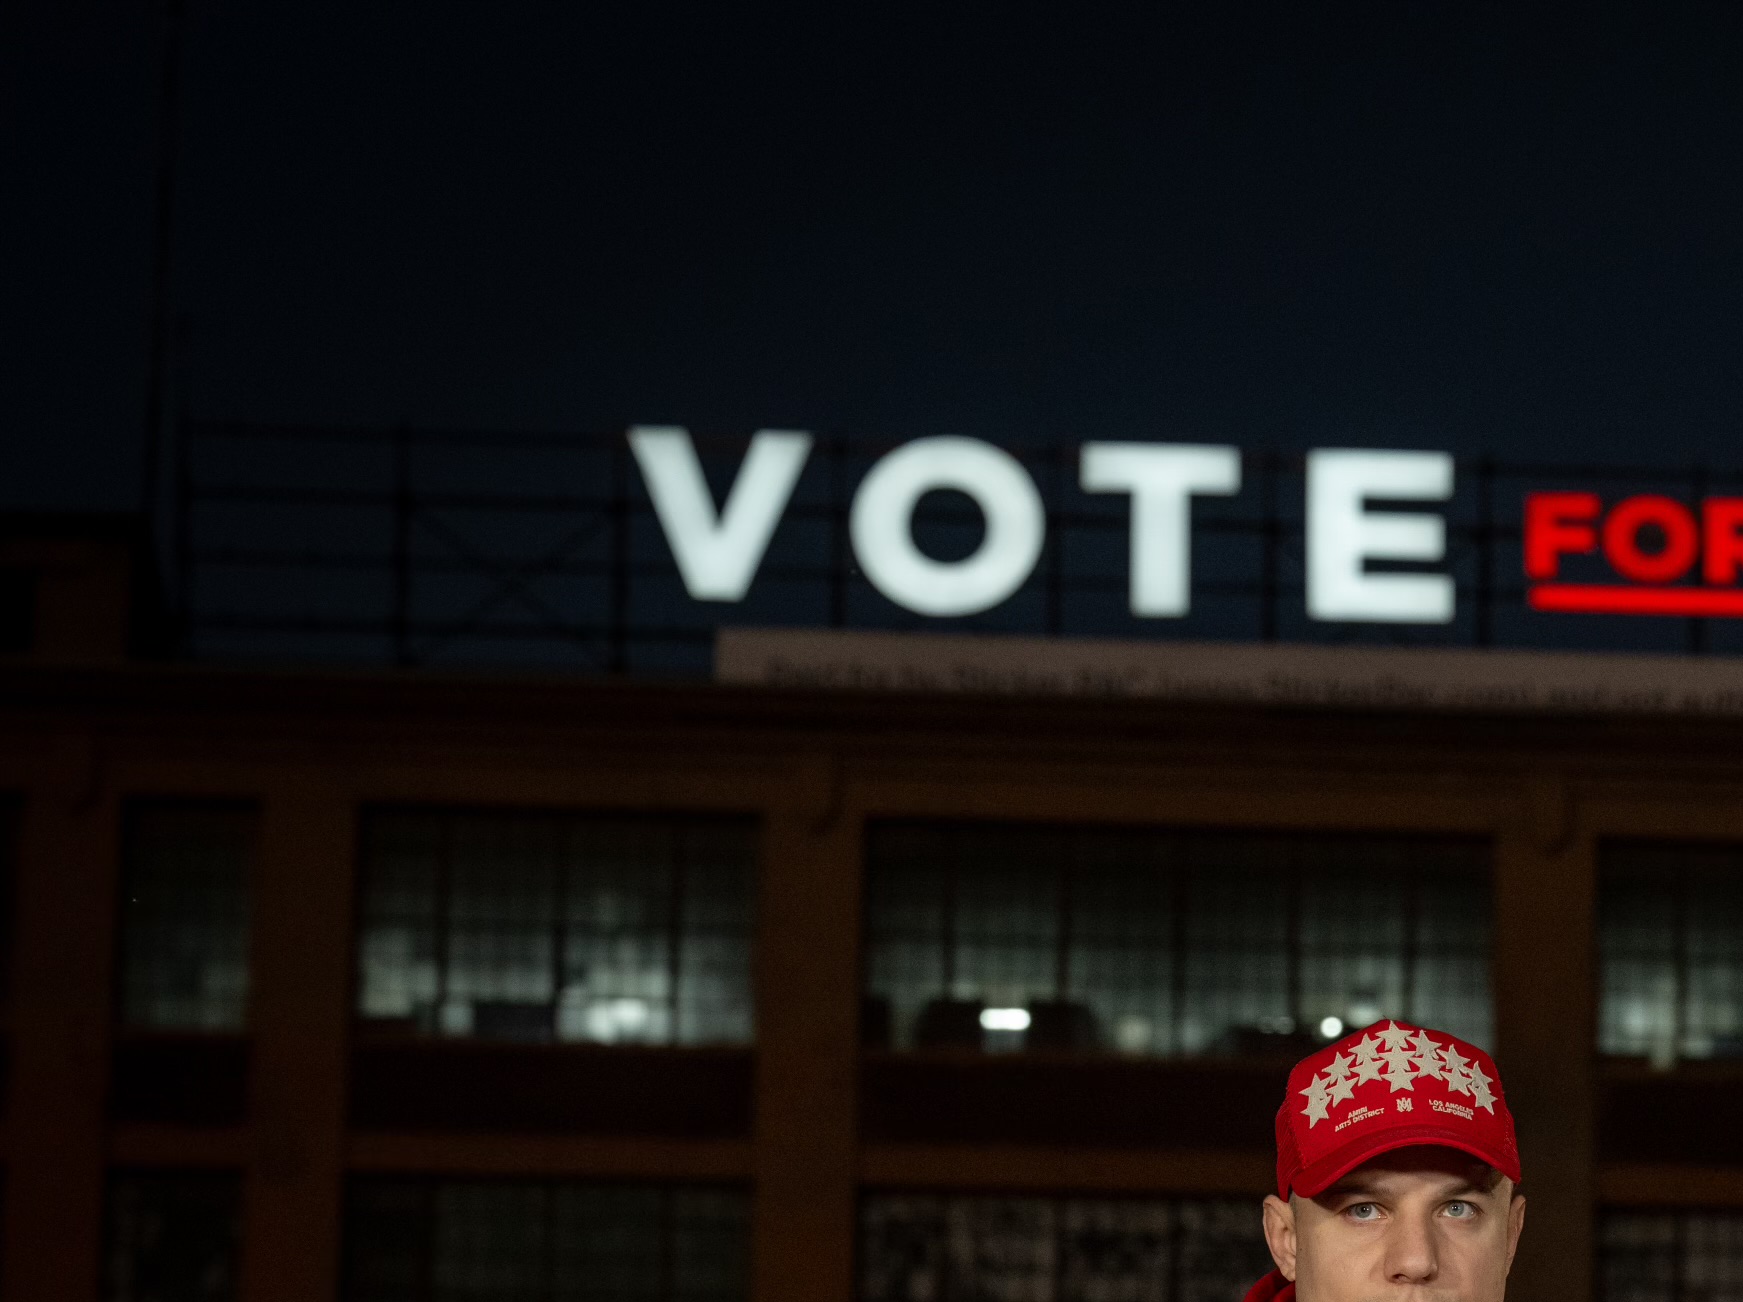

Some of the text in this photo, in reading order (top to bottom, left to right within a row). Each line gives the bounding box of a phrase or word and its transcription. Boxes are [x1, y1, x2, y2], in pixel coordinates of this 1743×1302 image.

[630, 428, 1456, 624] VOTE
[1429, 1099, 1475, 1116] LOS ANGELES
[1335, 1108, 1385, 1132] ARTS DISTRICT
